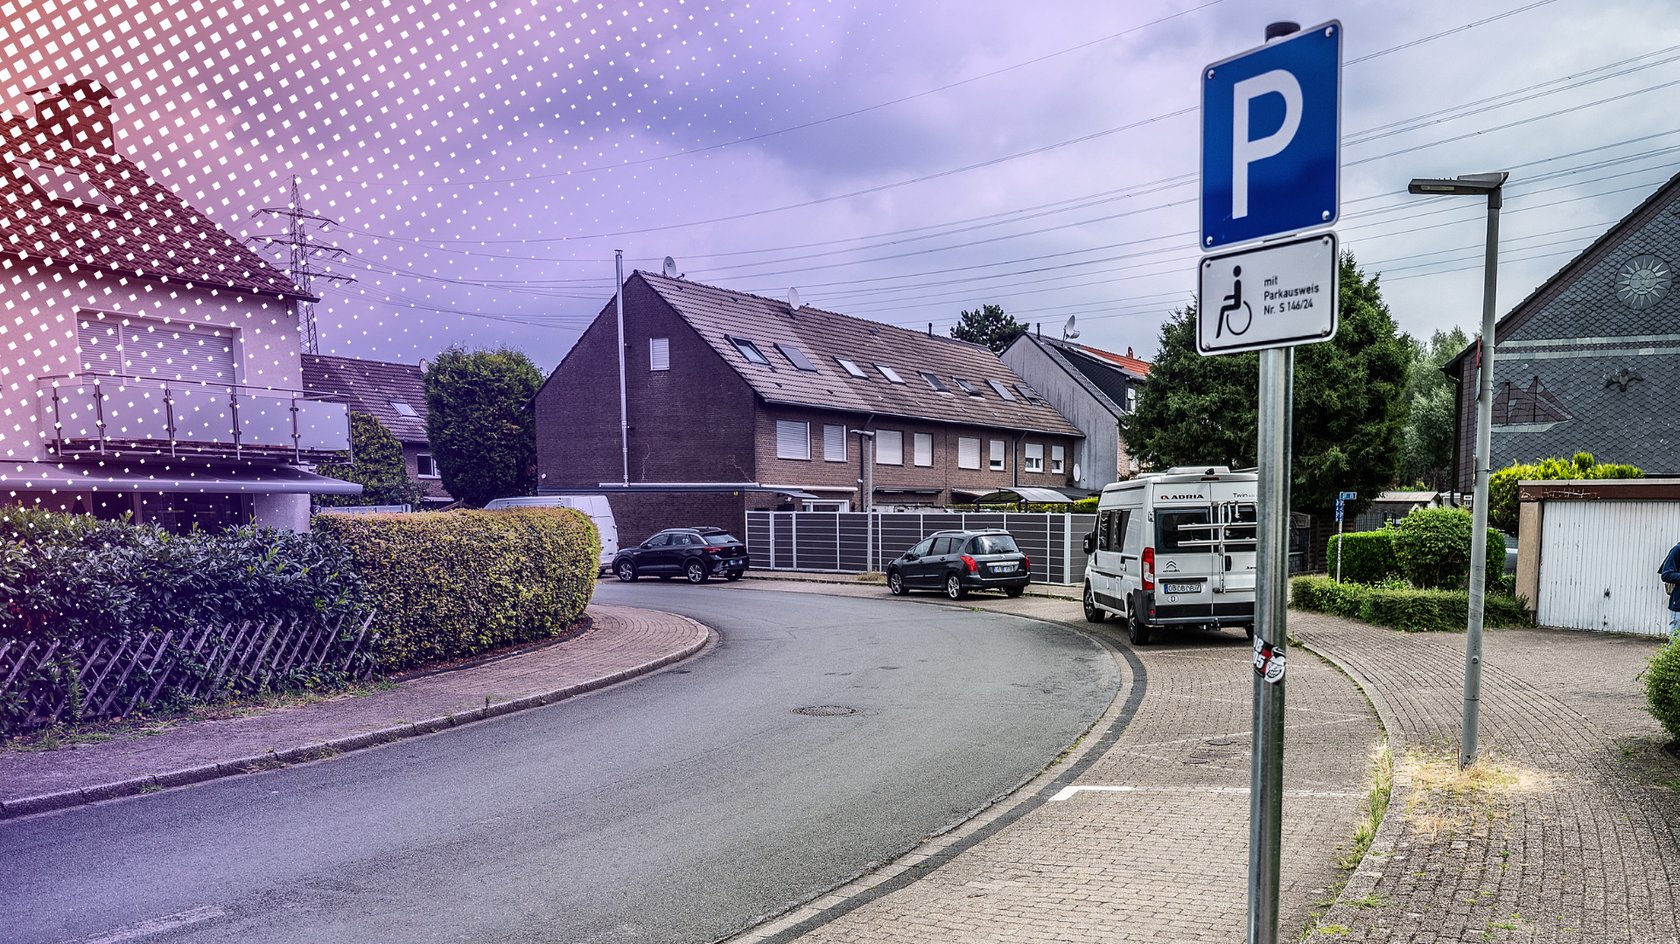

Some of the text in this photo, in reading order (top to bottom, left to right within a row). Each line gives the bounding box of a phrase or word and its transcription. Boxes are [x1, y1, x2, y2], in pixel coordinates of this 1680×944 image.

[1232, 69, 1303, 219] P
[1263, 276, 1278, 287] mit
[1263, 283, 1319, 301] Parkausweis
[1263, 298, 1313, 315] Nr. S 146/24
